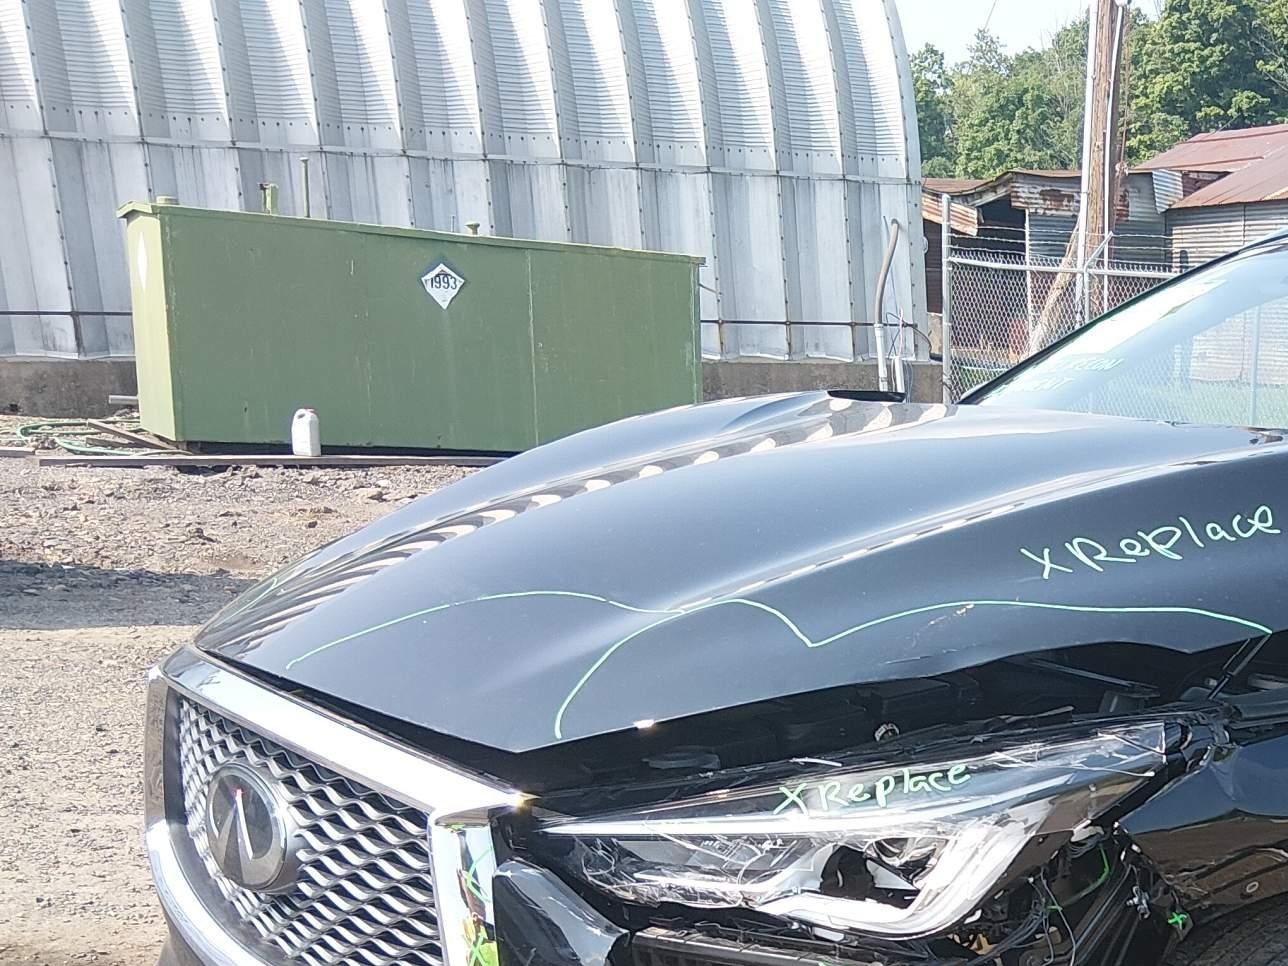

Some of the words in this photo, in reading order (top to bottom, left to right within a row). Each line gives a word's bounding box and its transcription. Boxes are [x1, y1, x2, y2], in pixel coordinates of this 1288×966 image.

[430, 275, 458, 290] 1993
[1066, 504, 1281, 572] Replace
[818, 763, 972, 811] Replace
